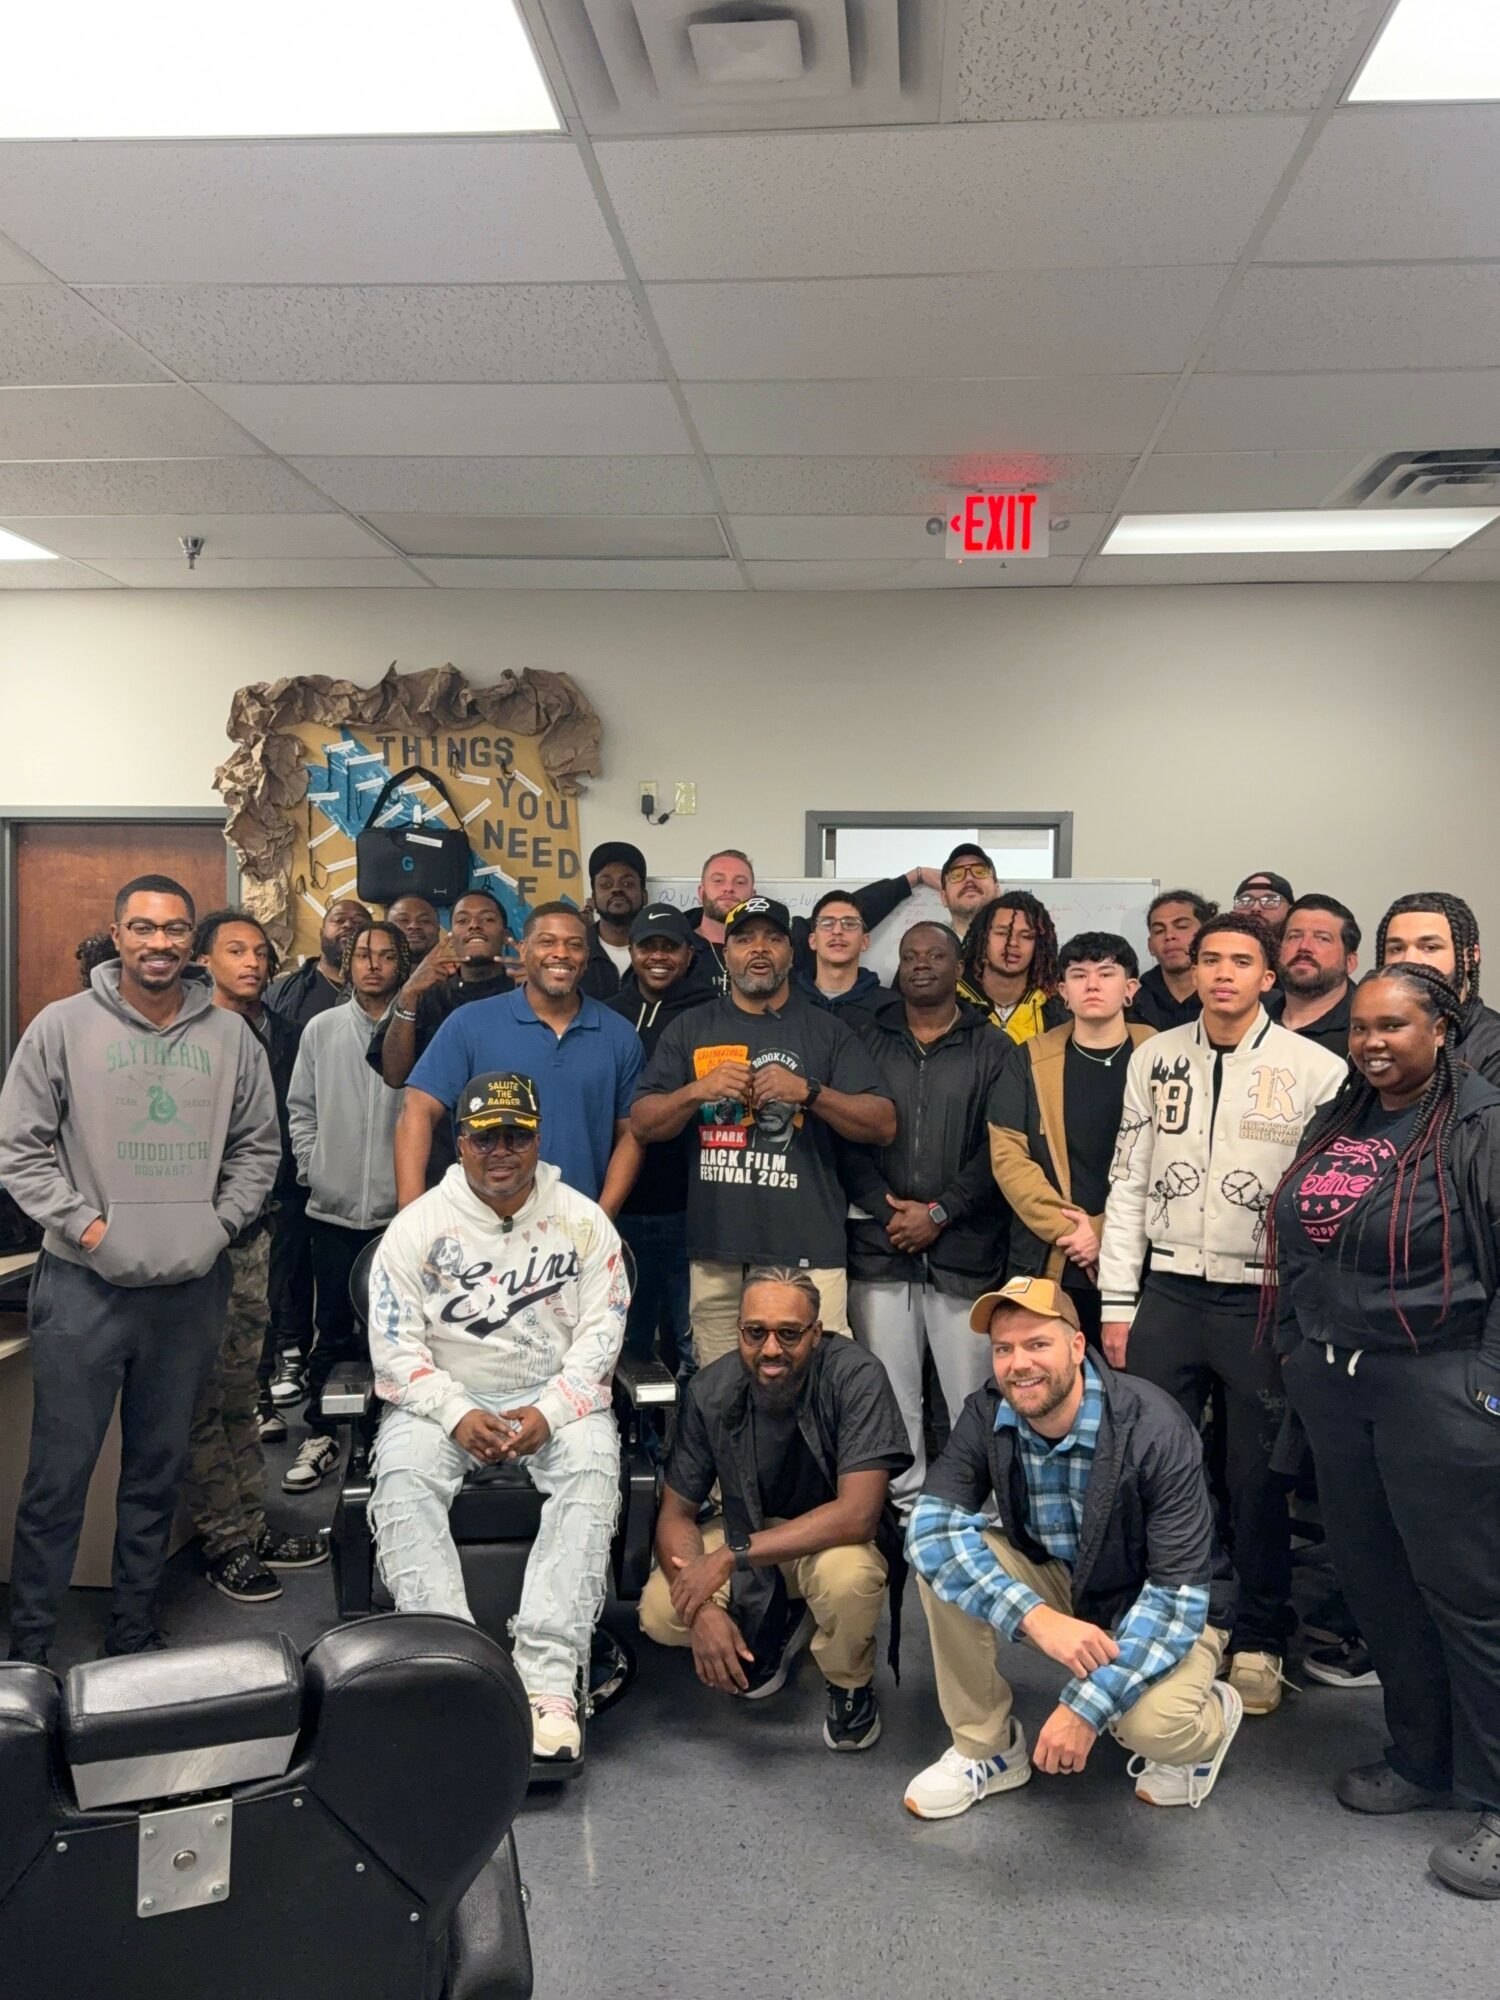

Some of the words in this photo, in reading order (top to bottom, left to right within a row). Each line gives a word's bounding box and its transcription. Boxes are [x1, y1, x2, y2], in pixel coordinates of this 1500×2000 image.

[964, 494, 1037, 551] EXIT
[375, 736, 514, 768] THINGS
[496, 777, 569, 831] YOU
[483, 819, 579, 879] NEED
[401, 856, 415, 872] G
[752, 1051, 798, 1070] BROOKLYN
[487, 1081, 519, 1091] SALUTE
[496, 1090, 512, 1098] THE
[1242, 1065, 1302, 1122] R
[715, 1130, 744, 1143] PARK
[116, 1140, 209, 1161] QUIDDITCH
[700, 1148, 740, 1167] BLACK
[745, 1151, 787, 1172] FILM
[700, 1165, 752, 1184] FESTIVAL
[757, 1170, 798, 1189] 2025
